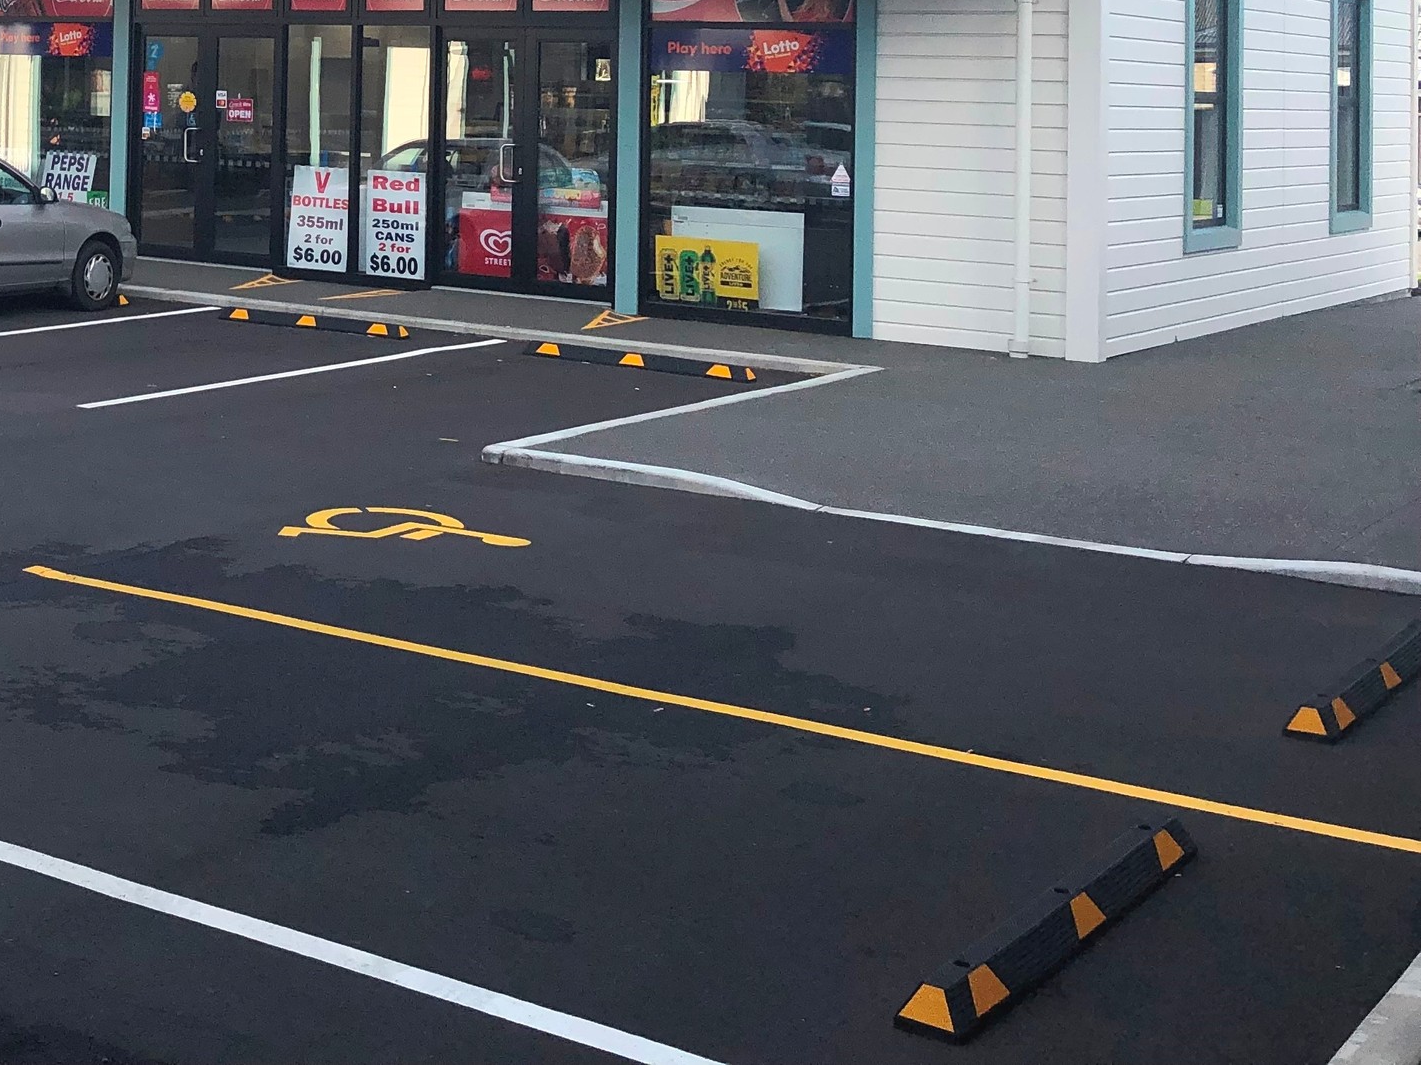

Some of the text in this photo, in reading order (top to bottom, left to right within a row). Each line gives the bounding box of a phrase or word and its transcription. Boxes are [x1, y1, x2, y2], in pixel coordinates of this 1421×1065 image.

[0, 31, 40, 43] Play here
[59, 30, 82, 43] Lotto
[668, 41, 732, 56] Play here
[763, 39, 800, 55] Lotto
[229, 110, 251, 119] OPEN
[51, 155, 91, 173] PEPSI
[45, 173, 91, 192] RANGE
[315, 171, 331, 194] V
[372, 175, 420, 192] Red
[292, 195, 349, 210] BOTTLES
[372, 198, 419, 215] Bull
[296, 215, 343, 231] 355ml
[372, 218, 419, 231] 250ml
[304, 233, 333, 245] 2 for
[375, 231, 415, 243] CANS
[292, 245, 342, 265] $6.00
[378, 242, 411, 253] 2 for
[370, 252, 418, 275] $6.00
[664, 254, 675, 294] LIVE+
[685, 255, 695, 296] LIVE+
[720, 272, 752, 282] ADVENTURE
